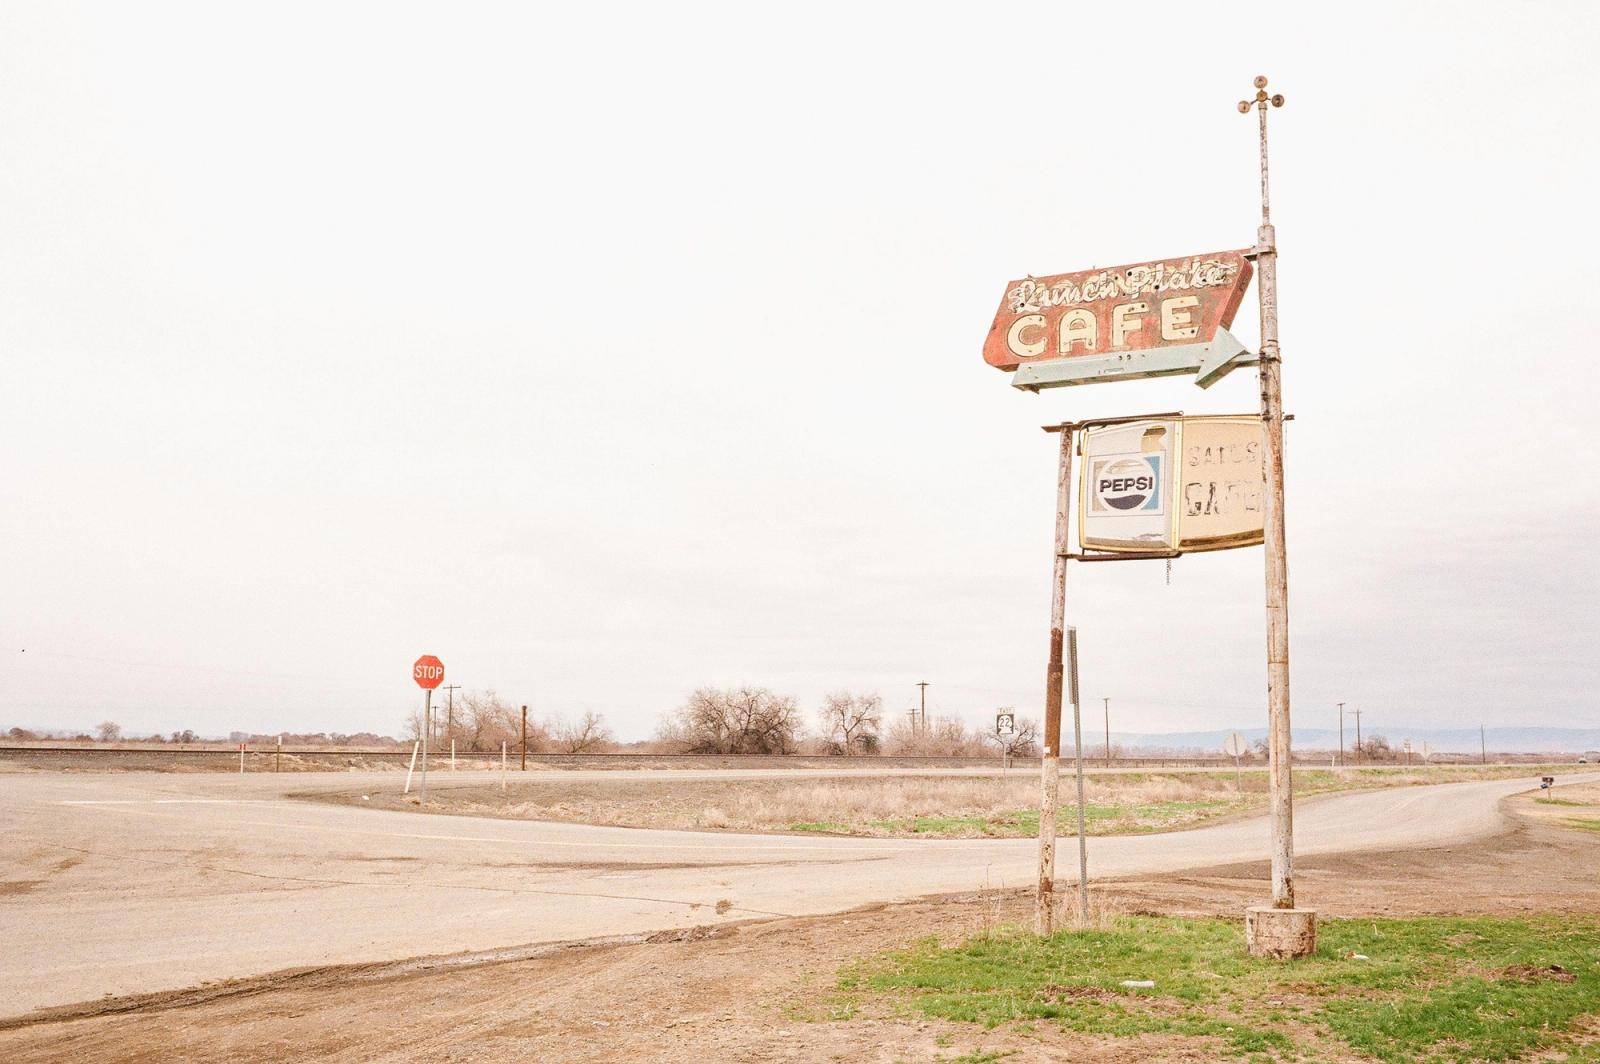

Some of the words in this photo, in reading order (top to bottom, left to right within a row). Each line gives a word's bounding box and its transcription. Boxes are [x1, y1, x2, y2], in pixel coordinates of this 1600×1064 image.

[1008, 271, 1118, 313] Lunch
[1007, 295, 1200, 357] CAFE
[1099, 476, 1153, 492] PEPSI
[415, 665, 443, 679] STOP
[999, 717, 1010, 728] 22
